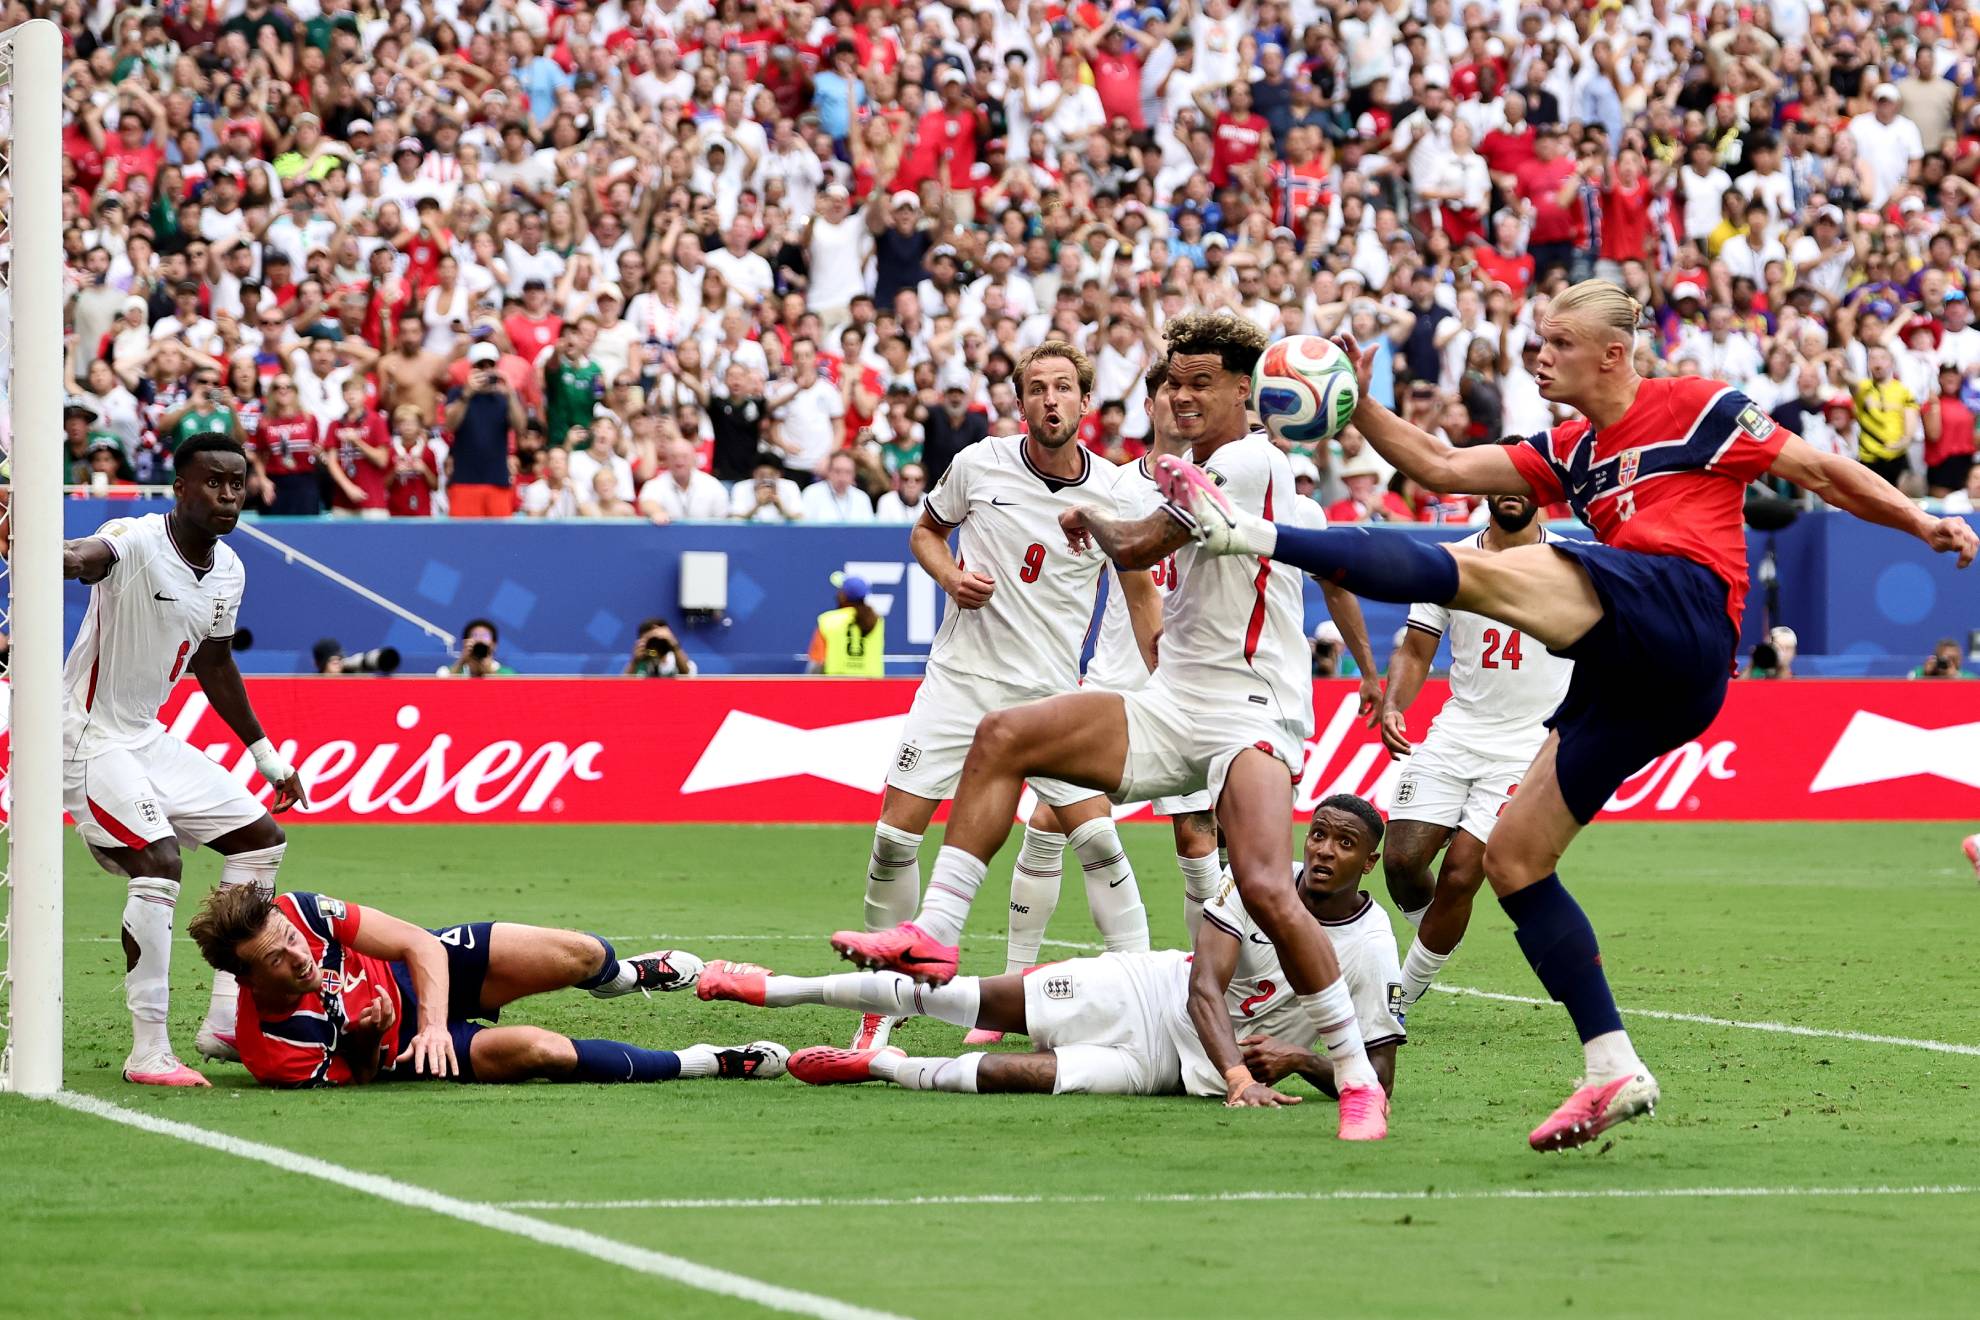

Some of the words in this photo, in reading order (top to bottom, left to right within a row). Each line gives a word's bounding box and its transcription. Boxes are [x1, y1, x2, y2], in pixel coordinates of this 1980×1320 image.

[1019, 542, 1047, 584] 9
[168, 639, 191, 683] 6
[1481, 627, 1523, 670] 24
[1010, 900, 1030, 915] ENG
[1239, 978, 1277, 1018] 2
